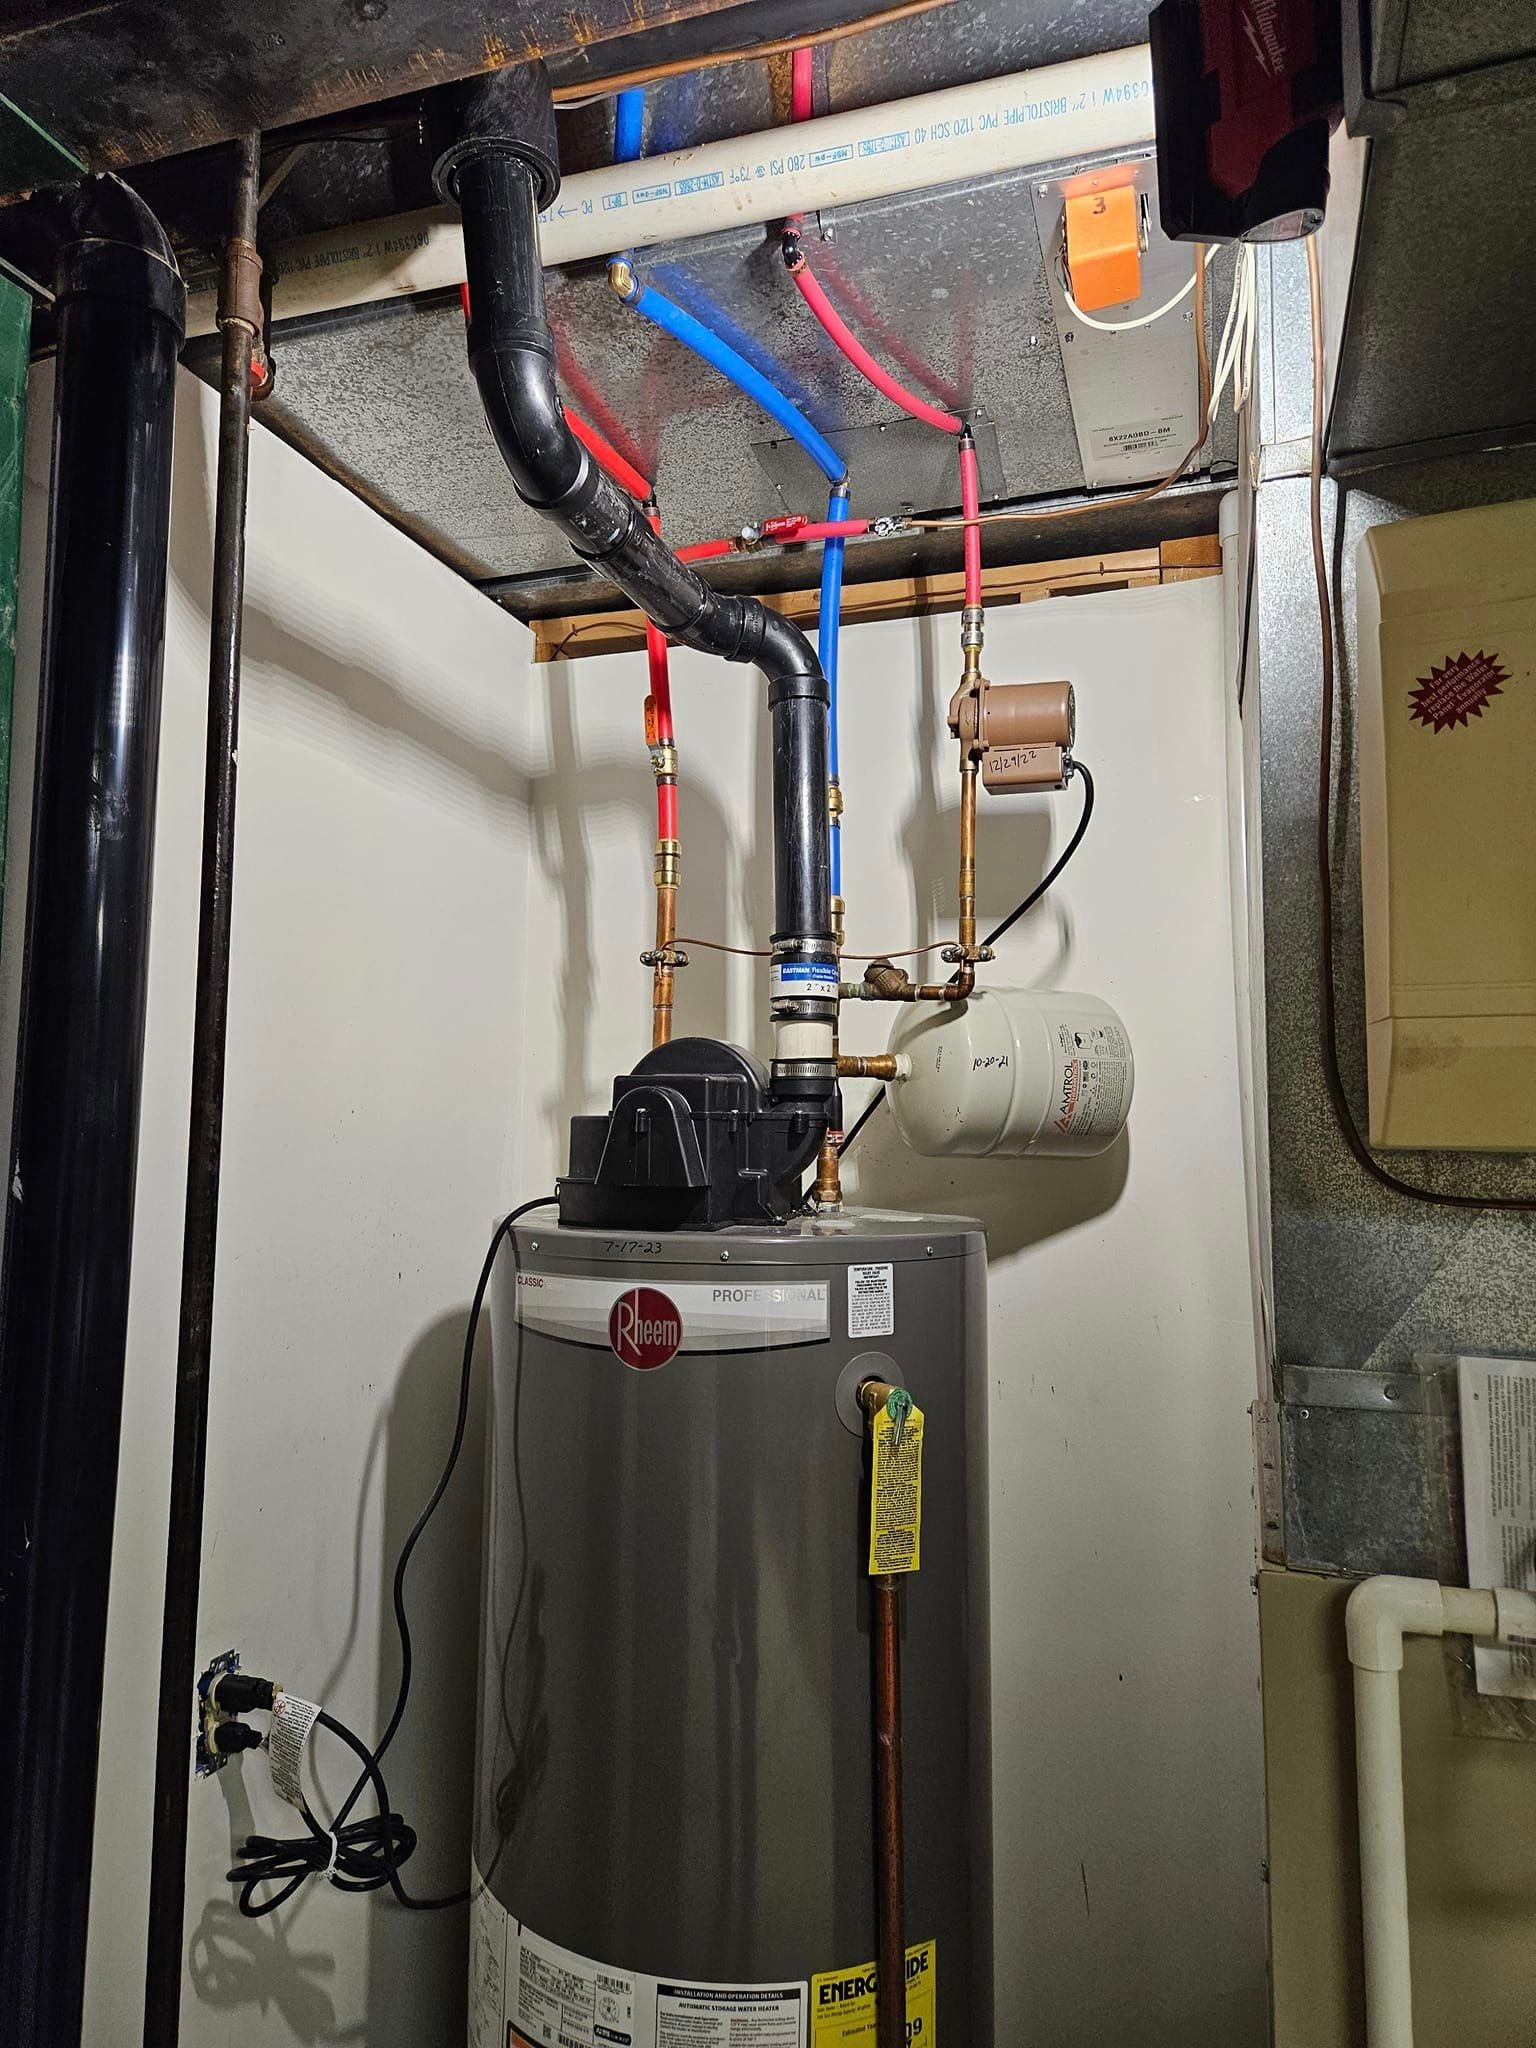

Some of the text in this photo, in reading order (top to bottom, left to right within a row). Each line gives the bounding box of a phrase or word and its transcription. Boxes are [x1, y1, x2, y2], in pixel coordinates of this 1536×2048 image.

[1004, 96, 1067, 127] BRISTOLPIPE
[930, 122, 950, 139] SCH
[954, 116, 974, 136] 1120
[978, 112, 998, 131] PVC
[914, 127, 927, 145] 40
[770, 159, 784, 175] PSI
[788, 154, 806, 172] 280
[581, 199, 593, 214] PC
[1093, 196, 1106, 214] 3
[1421, 659, 1481, 707] best performance
[1429, 665, 1460, 689] For very
[1456, 670, 1496, 701] Evaporator
[1428, 663, 1488, 714] replace the Water
[1456, 688, 1488, 713] annually
[989, 750, 1037, 773] 12/29/22
[973, 1055, 1009, 1071] 10-20-21
[1059, 1062, 1073, 1115] AMTROL
[604, 1241, 663, 1254] 7-17-23
[517, 1275, 544, 1288] CLASSIC
[616, 1289, 678, 1356] Rheem
[674, 1989, 713, 1999] INSTALLATION
[679, 2003, 710, 2011] AUTOMATIC
[712, 2004, 736, 2012] STORAGE
